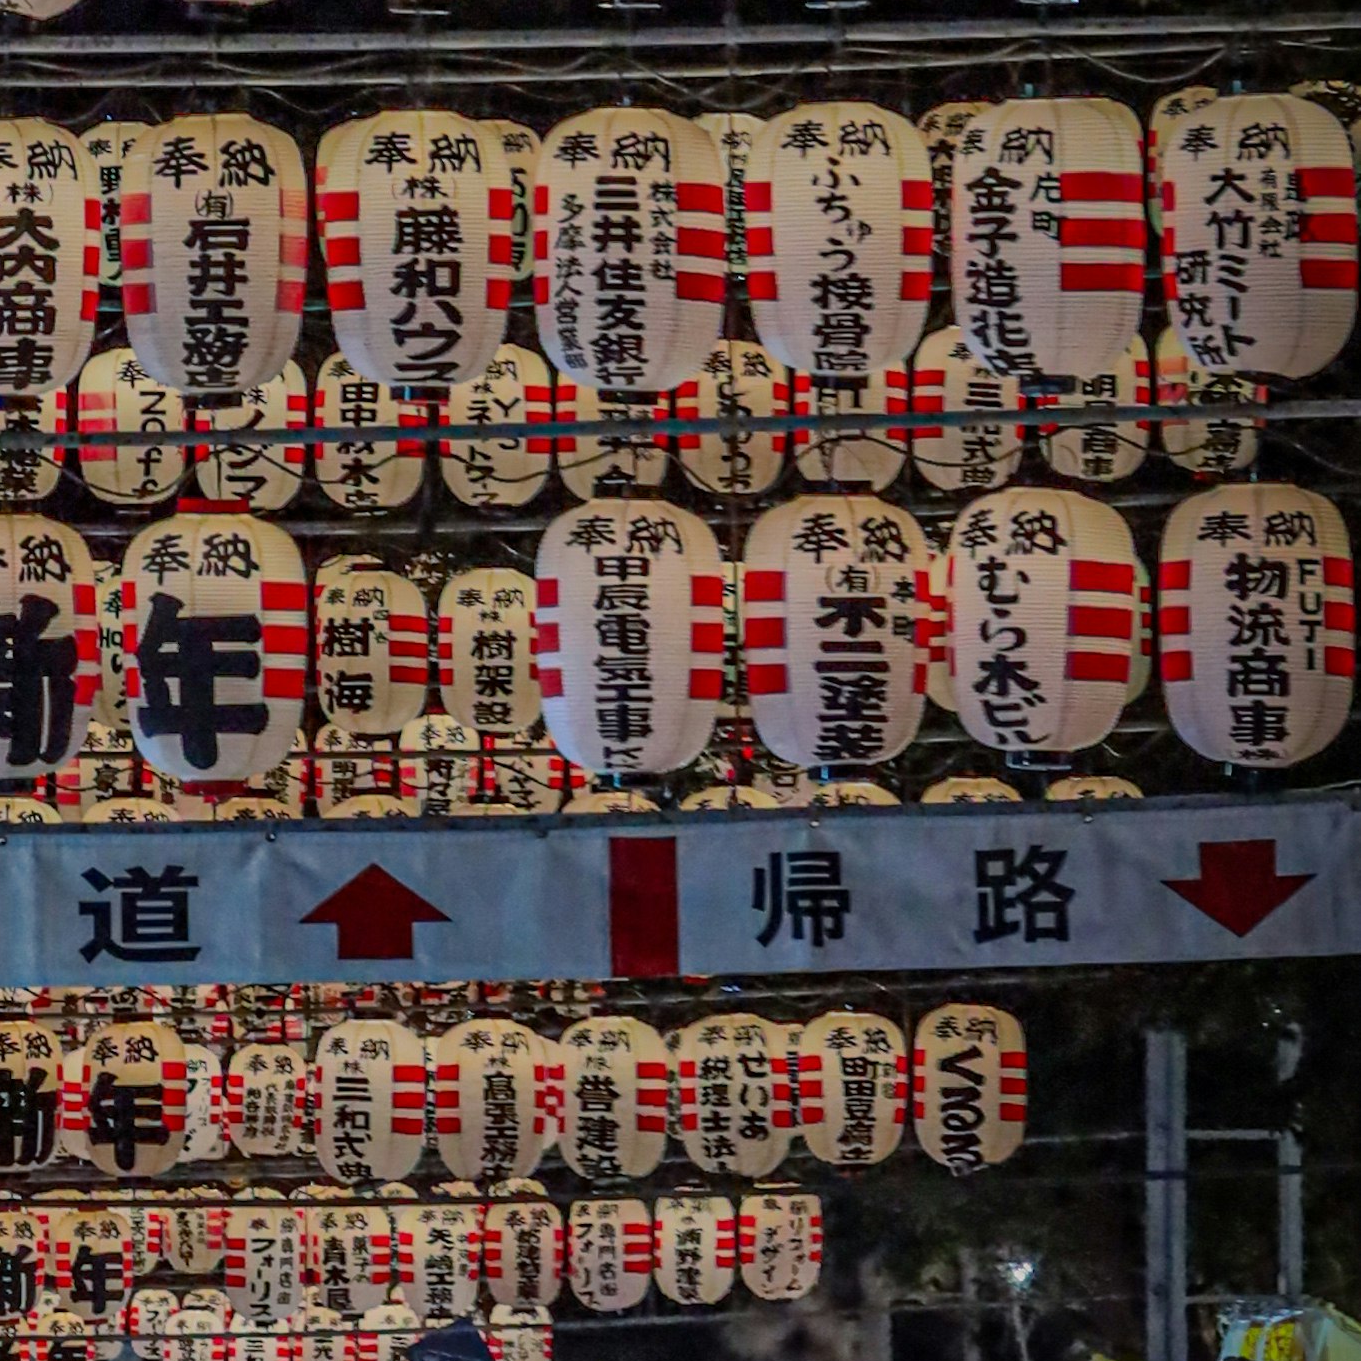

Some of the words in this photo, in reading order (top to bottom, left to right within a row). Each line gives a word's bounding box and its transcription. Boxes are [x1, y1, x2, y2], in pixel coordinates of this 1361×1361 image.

[556, 131, 674, 170] 奉納
[650, 179, 675, 282] 株式会社
[1205, 170, 1260, 357] 大竹ミート
[591, 176, 646, 388] 三井住友銀行
[141, 533, 258, 579] 奉納
[794, 516, 909, 561] 奉納
[891, 576, 915, 641] 本町
[1226, 555, 1291, 745] 物流商事
[139, 594, 266, 770] 年
[324, 617, 374, 715] 樹海
[753, 844, 1077, 947] 帰路
[87, 1073, 170, 1170] 年
[333, 1076, 373, 1180] 三和式典
[71, 1247, 125, 1313] 年
